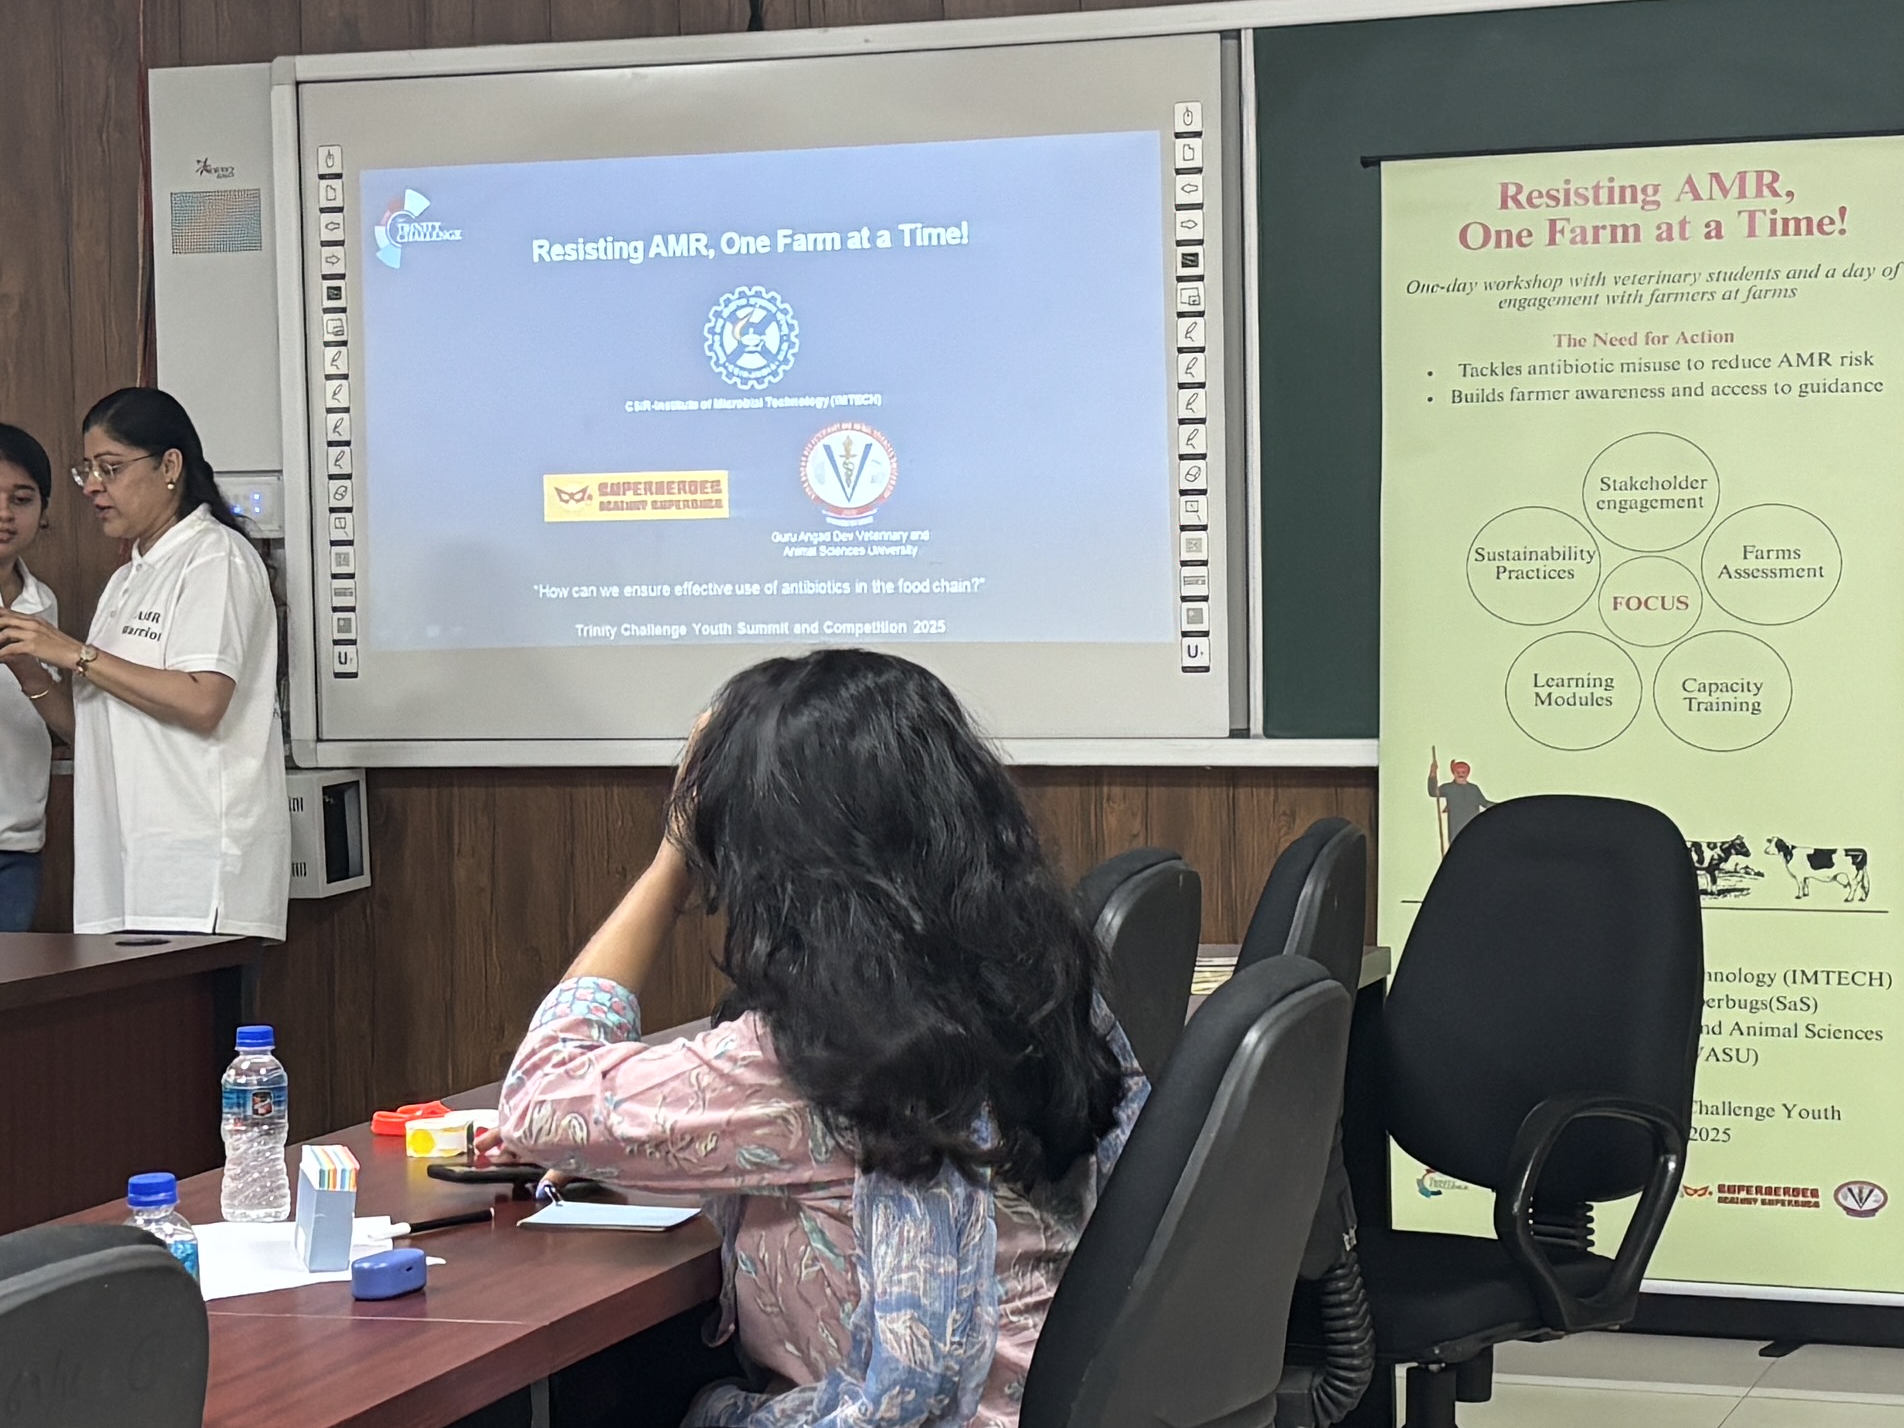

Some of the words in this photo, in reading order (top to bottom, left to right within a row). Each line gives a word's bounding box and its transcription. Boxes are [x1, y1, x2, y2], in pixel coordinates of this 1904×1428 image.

[1498, 177, 1661, 210] Resisting
[1675, 169, 1796, 204] AMR,
[1459, 222, 1533, 250] One
[1546, 216, 1641, 246] Farm
[1655, 213, 1690, 241] at
[1704, 219, 1724, 241] a
[1738, 205, 1848, 238] Time!
[533, 236, 645, 263] Resisting
[648, 232, 716, 259] AMR,
[721, 231, 771, 255] One
[776, 228, 843, 252] Farm
[847, 227, 872, 250] at
[875, 229, 892, 248] a
[898, 221, 969, 246] Time!
[1406, 278, 1478, 295] One-day
[1484, 274, 1562, 292] workshop
[1570, 272, 1606, 287] with
[1614, 270, 1701, 286] veterinary
[1706, 266, 1780, 283] students
[1786, 264, 1821, 279] and
[1825, 268, 1836, 278] a
[1842, 263, 1876, 281] day
[1882, 261, 1904, 280] of
[1498, 292, 1599, 311] engagement
[1606, 289, 1643, 305] with
[1645, 288, 1716, 307] farmers
[1722, 287, 1740, 301] at
[1742, 285, 1798, 303] farms
[1553, 334, 1586, 348] The
[1593, 332, 1637, 347] Need
[1645, 331, 1669, 345] for
[1676, 330, 1734, 344] Action
[1458, 362, 1522, 377] Tackles
[1528, 358, 1614, 375] antibiotic
[1620, 358, 1680, 372] misuse
[1688, 358, 1704, 370] to
[1712, 354, 1771, 370] reduce
[1778, 352, 1832, 368] AMR
[1840, 351, 1874, 366] risk
[1452, 388, 1504, 404] Builds
[1510, 387, 1570, 401] farmer
[1576, 388, 1665, 400] awareness
[1672, 382, 1704, 397] and
[1711, 384, 1767, 396] access
[1774, 382, 1792, 394] to
[1798, 378, 1883, 398] guidance
[1600, 475, 1708, 491] Stakeholder
[1597, 496, 1703, 513] engagement
[1474, 545, 1596, 564] Sustainability
[1743, 545, 1800, 560] Farms
[1496, 565, 1574, 580] Practices
[1718, 564, 1824, 579] Assessment
[572, 585, 596, 597] can
[600, 586, 619, 597] we
[624, 584, 670, 596] ensure
[674, 581, 732, 596] effective
[736, 583, 760, 595] use
[764, 580, 778, 595] of
[782, 580, 851, 596] antibiotics
[856, 580, 868, 593] in
[872, 580, 895, 594] the
[898, 578, 931, 594] food
[1613, 596, 1688, 610] FOCUS
[576, 624, 617, 640] Trinity
[621, 624, 688, 640] Challenge
[692, 623, 733, 635] Youth
[738, 622, 789, 636] Summit
[794, 621, 818, 634] and
[823, 620, 907, 640] Competition
[913, 620, 948, 634] 2025
[1534, 672, 1614, 691] Learning
[1682, 678, 1763, 698] Capacity
[1535, 690, 1612, 706] Modules
[1683, 696, 1761, 715] Training
[1783, 969, 1893, 990] (IMTECH)
[1705, 994, 1819, 1015] erbugs(SaS)
[1729, 1021, 1798, 1039] Animal
[1805, 1023, 1884, 1041] Sciences
[1782, 1103, 1842, 1121] Youth
[1689, 1126, 1731, 1143] 2025
